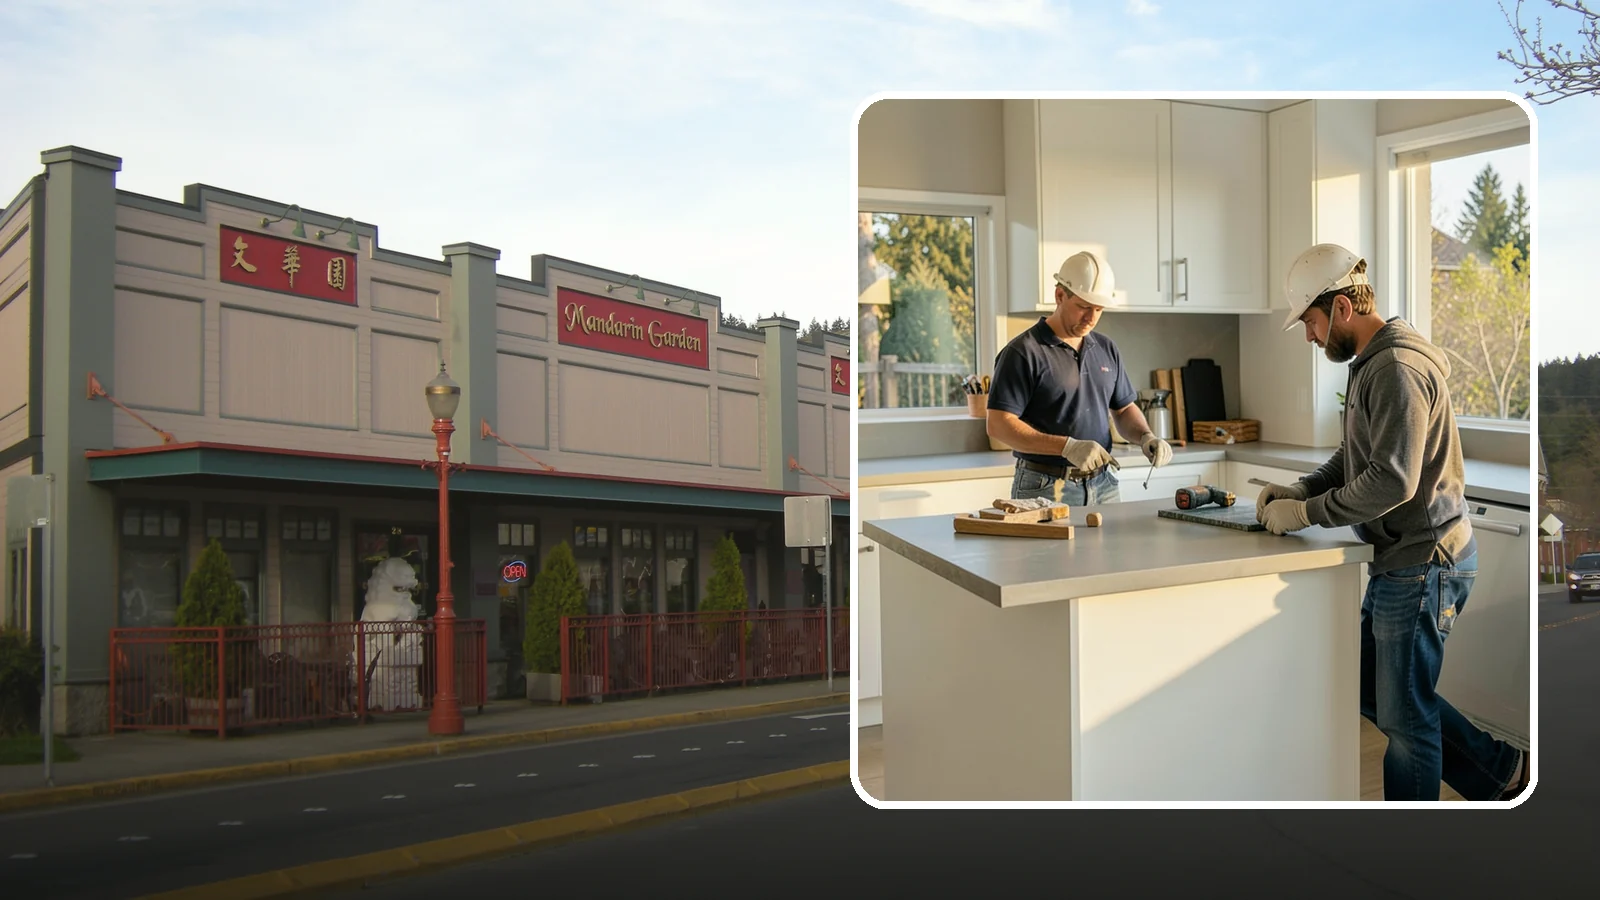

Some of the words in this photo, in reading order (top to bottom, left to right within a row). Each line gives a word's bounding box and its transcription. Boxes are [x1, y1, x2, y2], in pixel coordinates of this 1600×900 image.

[231, 235, 346, 290] 文華園
[565, 302, 644, 340] Mandarin
[648, 320, 702, 352] Garden
[503, 565, 527, 578] OPEN
